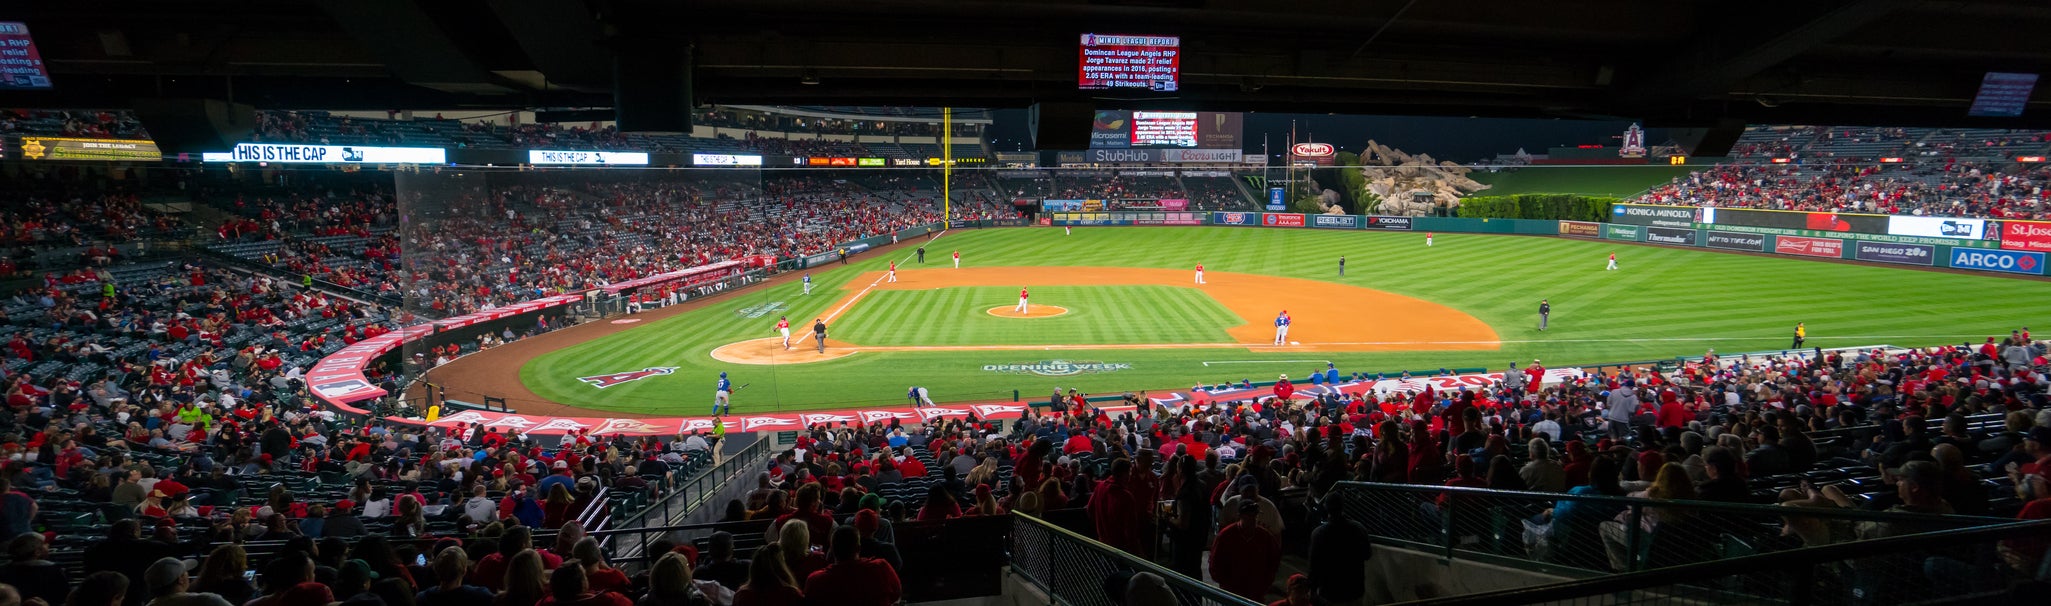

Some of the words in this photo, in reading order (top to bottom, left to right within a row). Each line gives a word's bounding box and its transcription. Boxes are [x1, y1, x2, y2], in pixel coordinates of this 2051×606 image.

[263, 146, 275, 160] IS
[277, 146, 300, 160] THE
[303, 147, 327, 161] CAP
[542, 152, 557, 162] THIS
[576, 153, 587, 162] CAP
[1096, 150, 1149, 162] StubHub
[1181, 150, 1210, 161] Coors
[1627, 208, 1655, 217] KONICA
[1656, 209, 1691, 218] MINOLTA
[1919, 238, 1960, 246] PROMISES
[1955, 252, 2014, 269] ARCO
